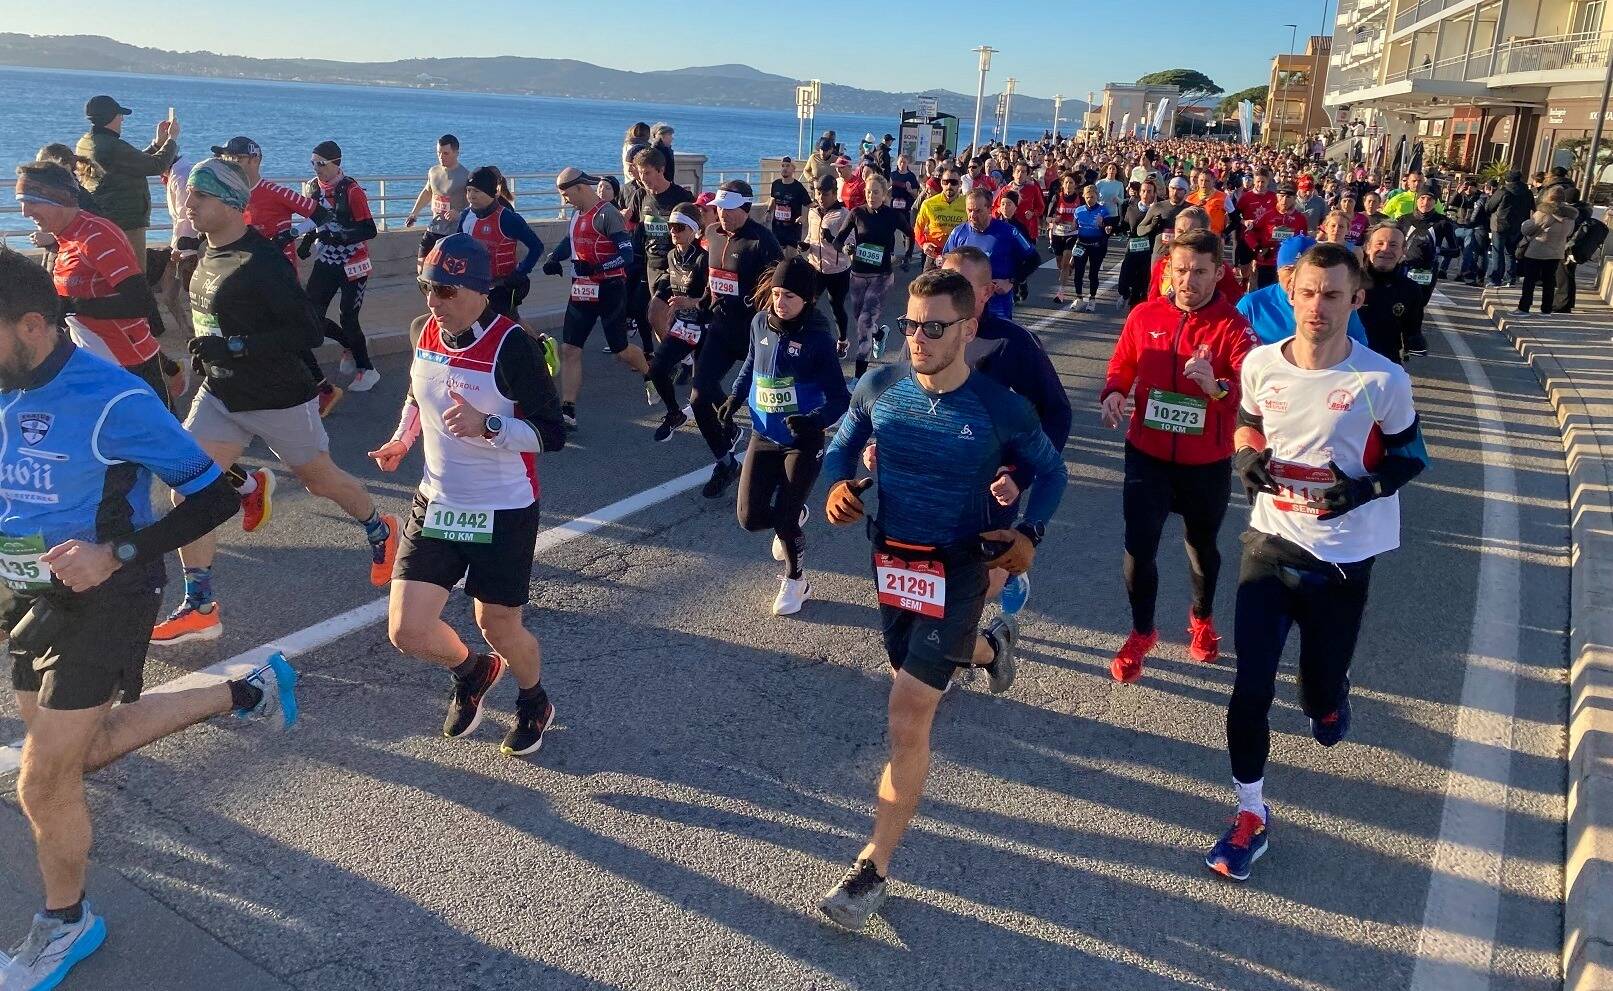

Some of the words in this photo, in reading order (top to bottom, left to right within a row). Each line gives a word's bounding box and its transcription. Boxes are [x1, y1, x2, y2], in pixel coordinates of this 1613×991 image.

[455, 382, 480, 391] VEOLIA
[1160, 423, 1171, 431] 10
[1172, 425, 1187, 433] KM
[1293, 504, 1320, 515] SEMI
[443, 531, 456, 539] 10
[457, 532, 475, 541] KM
[900, 597, 923, 612] SEMI
